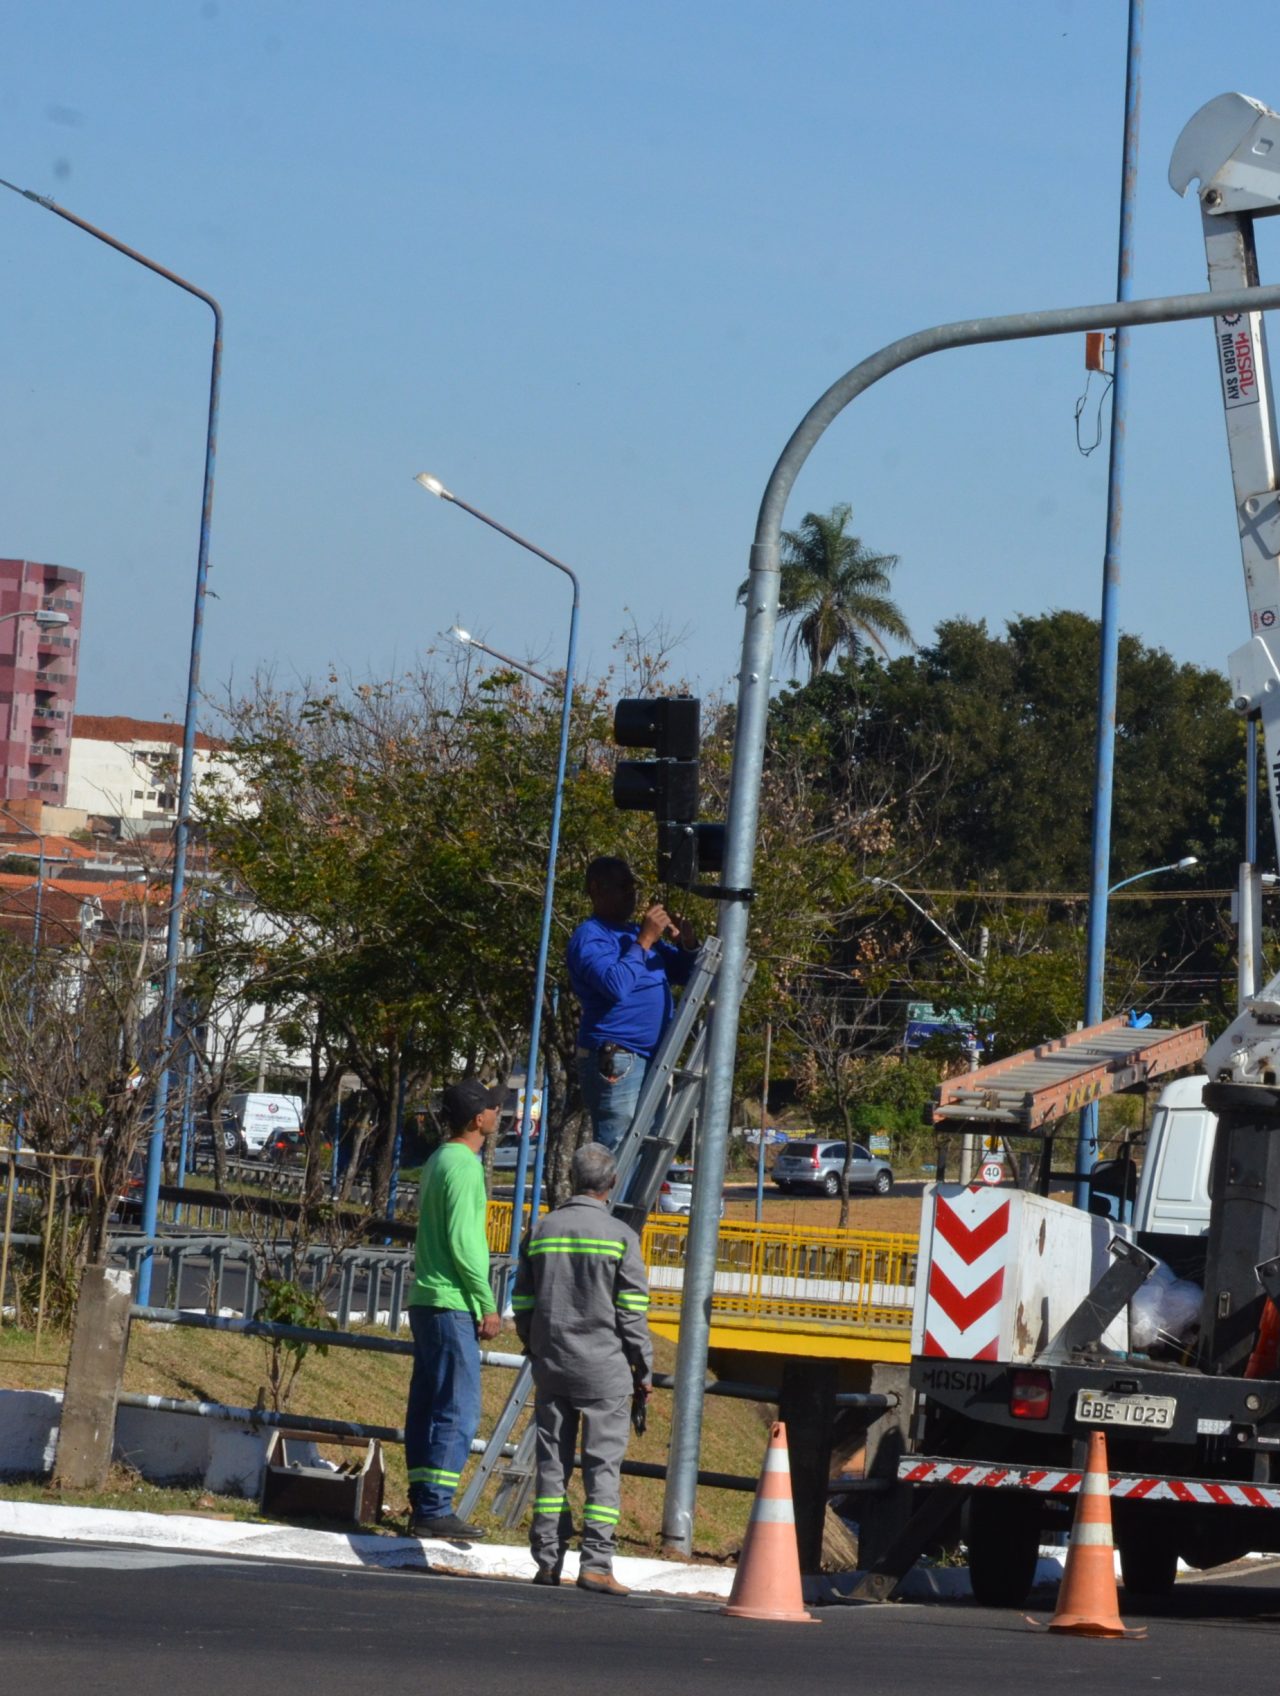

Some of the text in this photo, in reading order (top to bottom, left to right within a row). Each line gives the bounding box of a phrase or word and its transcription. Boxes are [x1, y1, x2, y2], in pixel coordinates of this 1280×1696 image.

[1221, 333, 1240, 400] MICRO SKY
[1234, 332, 1254, 396] MASAL
[985, 1167, 1000, 1177] 40
